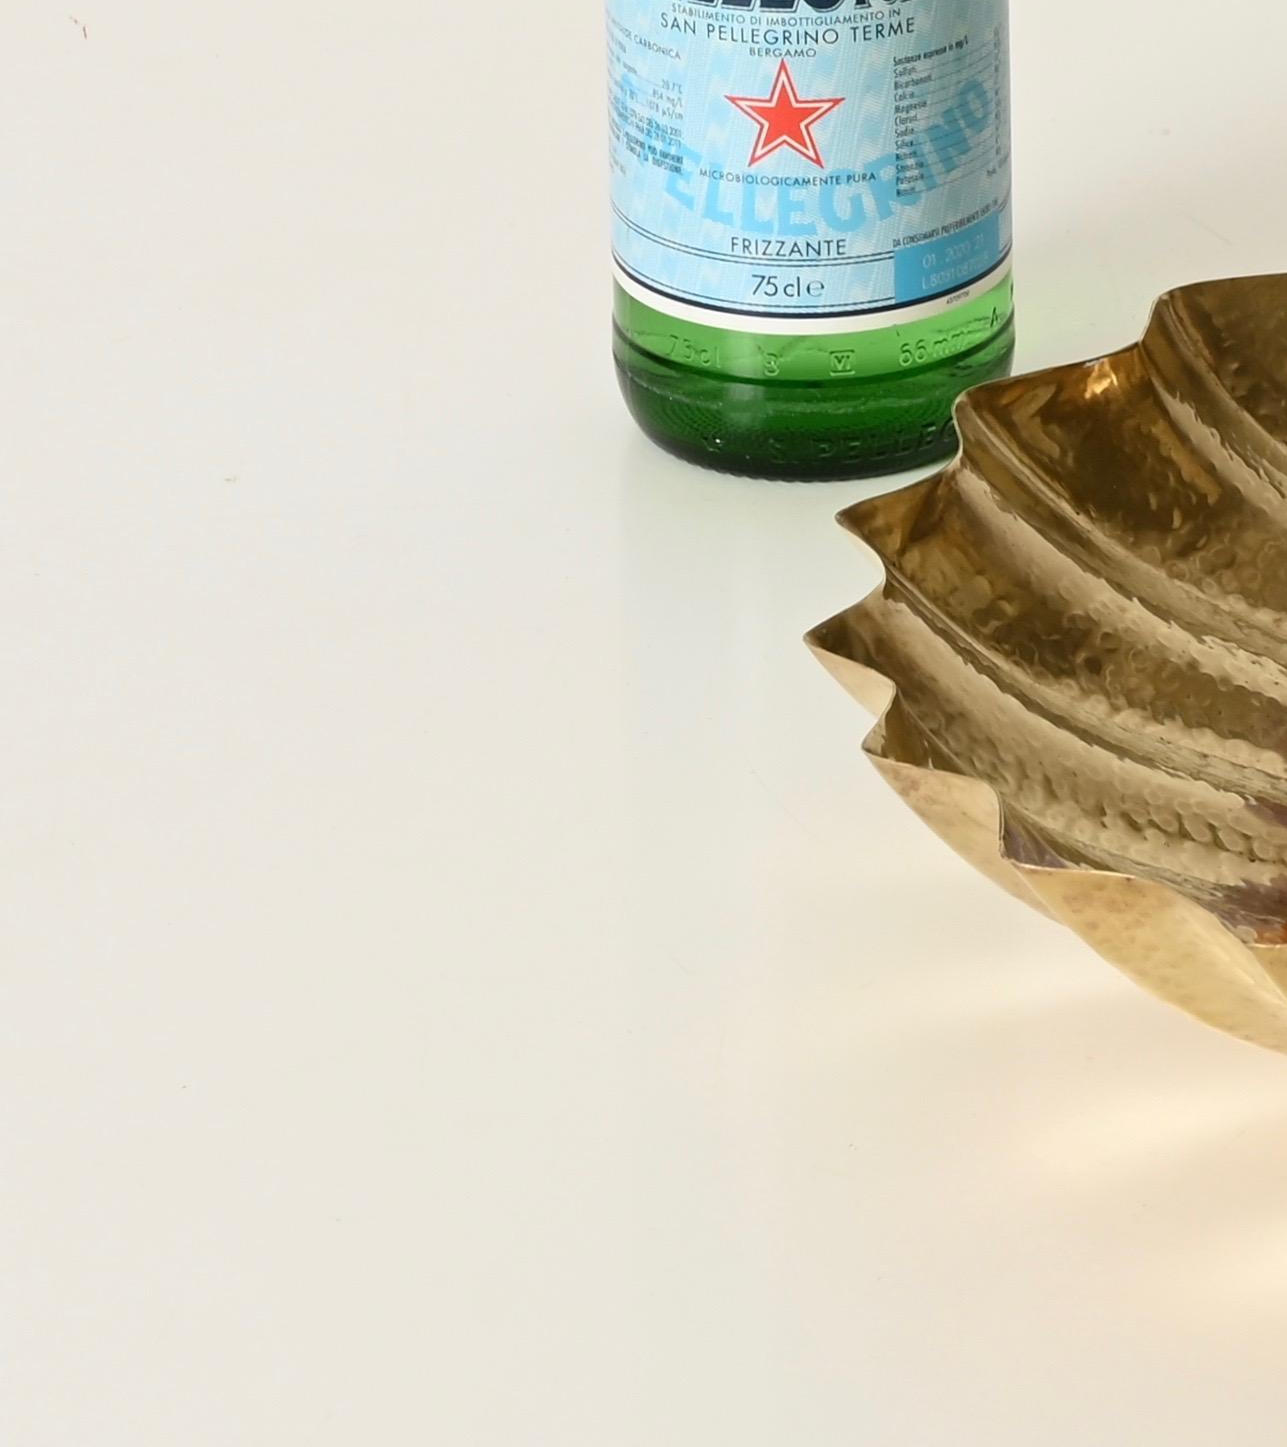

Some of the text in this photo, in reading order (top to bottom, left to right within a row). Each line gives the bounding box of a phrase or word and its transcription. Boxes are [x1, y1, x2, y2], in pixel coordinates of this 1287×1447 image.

[671, 3, 901, 27] STABILIMENTO DI IMBOTTIGLIAMENTO IN
[661, 12, 916, 45] SAN PELLEGRINO TERME
[749, 47, 817, 58] BERGAMO
[699, 168, 877, 187] MICROBIOLOGICAMENTE PURA
[730, 237, 847, 258] FRIZZANTE
